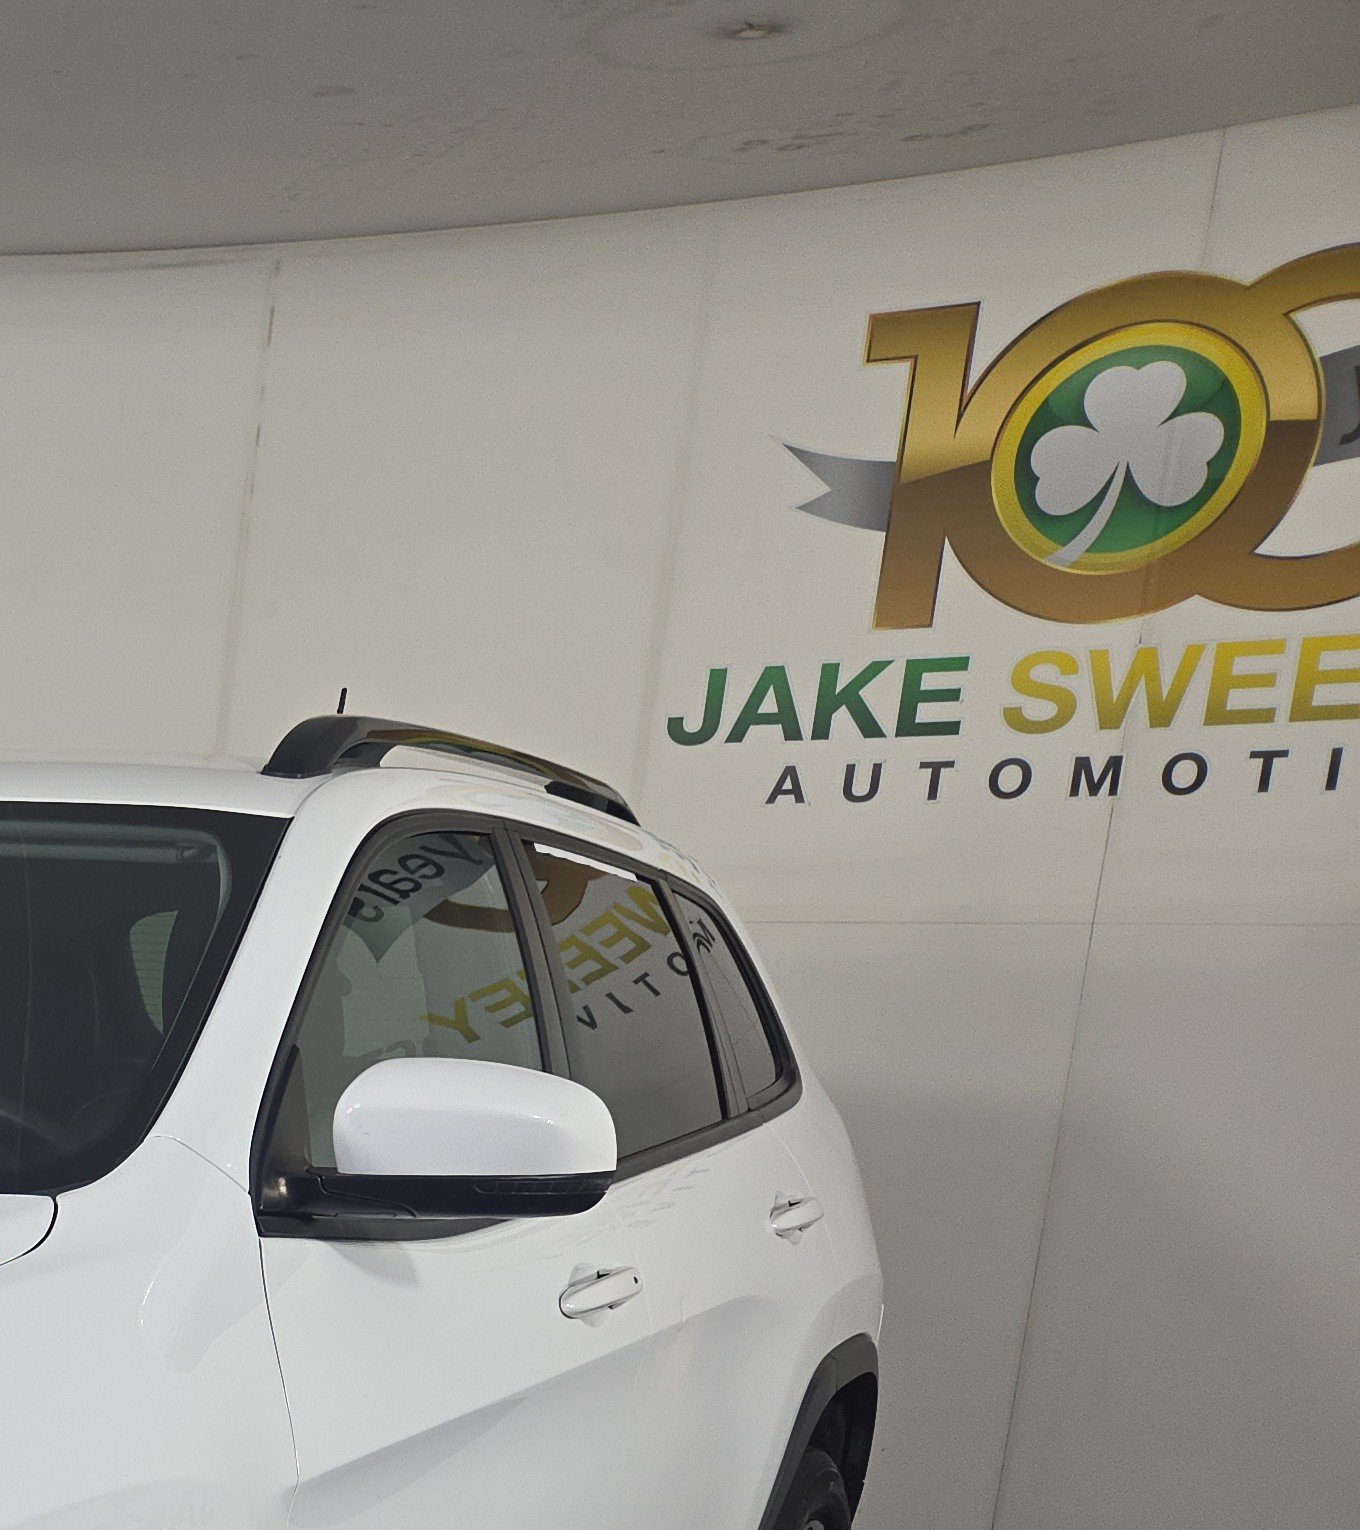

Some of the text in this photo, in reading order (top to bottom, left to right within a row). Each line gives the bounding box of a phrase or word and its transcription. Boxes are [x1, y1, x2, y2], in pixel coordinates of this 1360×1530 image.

[666, 634, 1360, 747] JAKE SWEE
[764, 746, 1345, 805] AUTOMOTI
